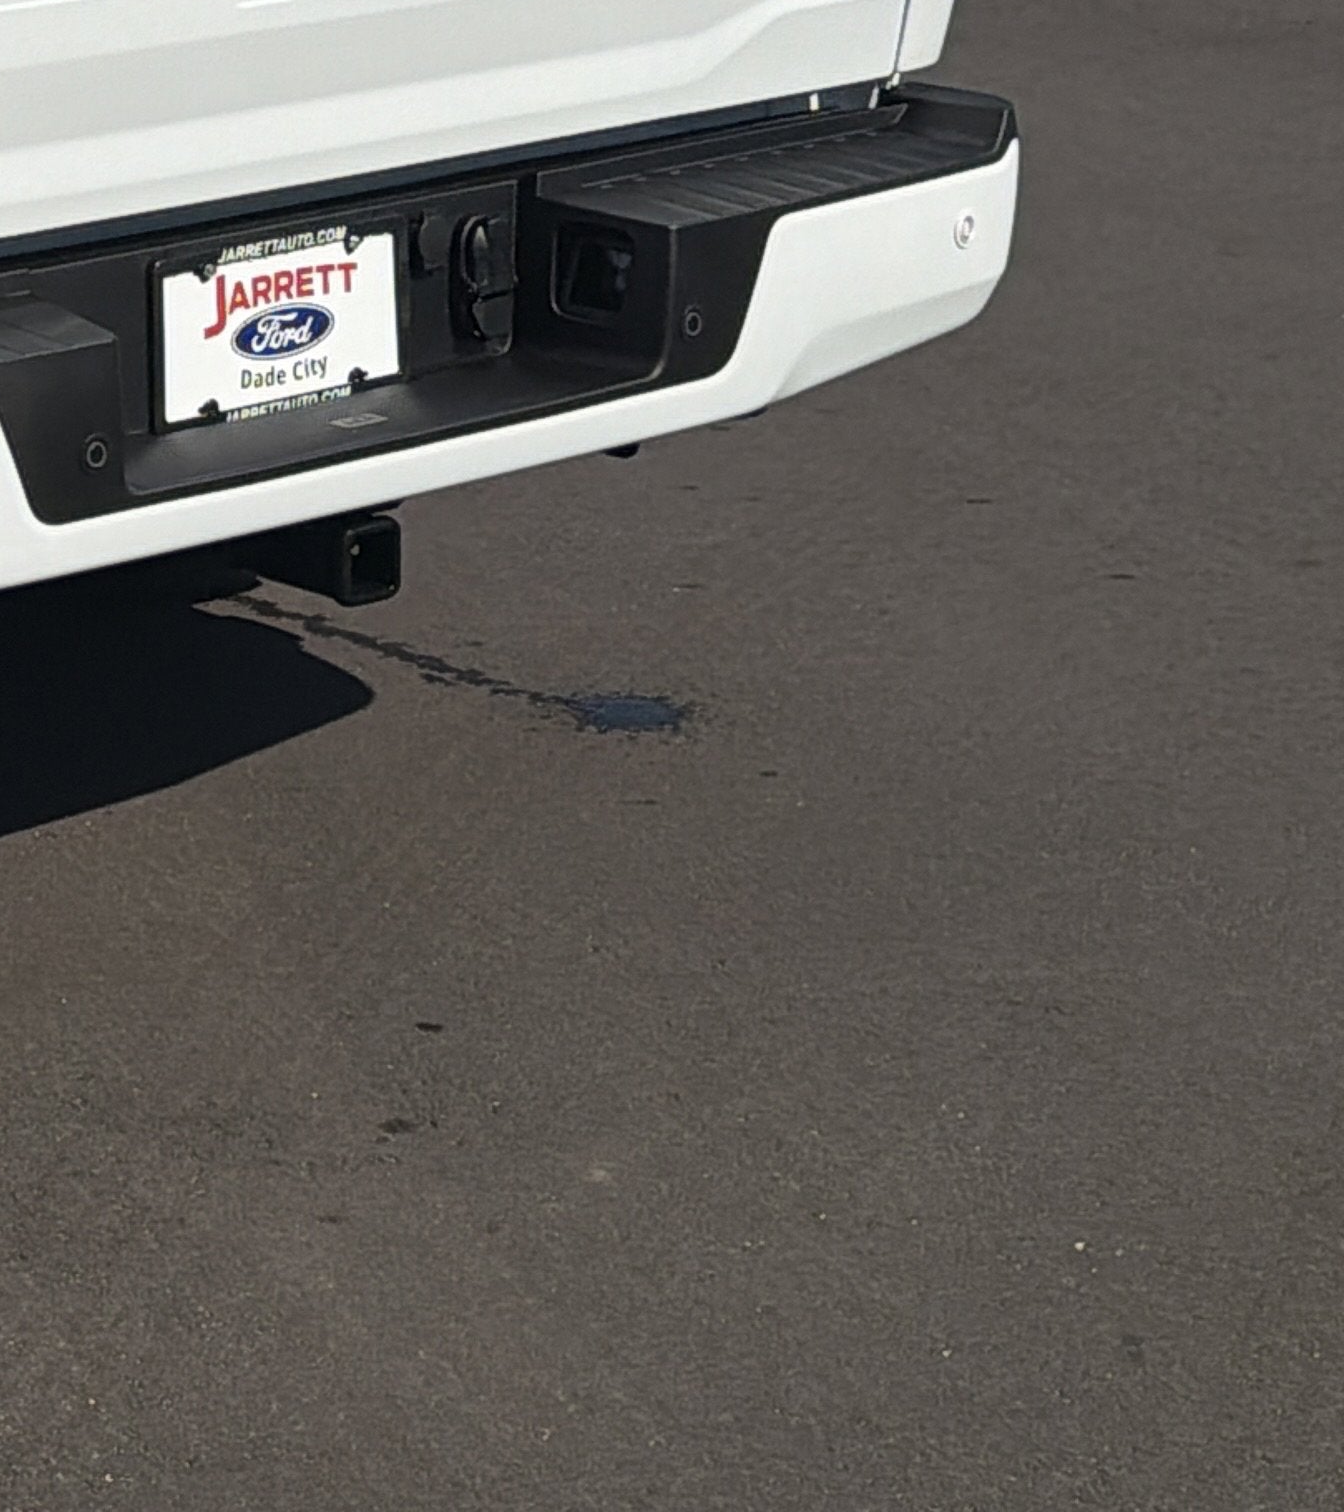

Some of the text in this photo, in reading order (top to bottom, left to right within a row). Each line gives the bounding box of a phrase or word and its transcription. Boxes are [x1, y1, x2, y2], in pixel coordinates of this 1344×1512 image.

[217, 225, 348, 264] JARRETTAUTO.COM
[204, 262, 358, 340] JARRETT
[251, 309, 312, 354] Ford
[240, 355, 328, 390] Dade City
